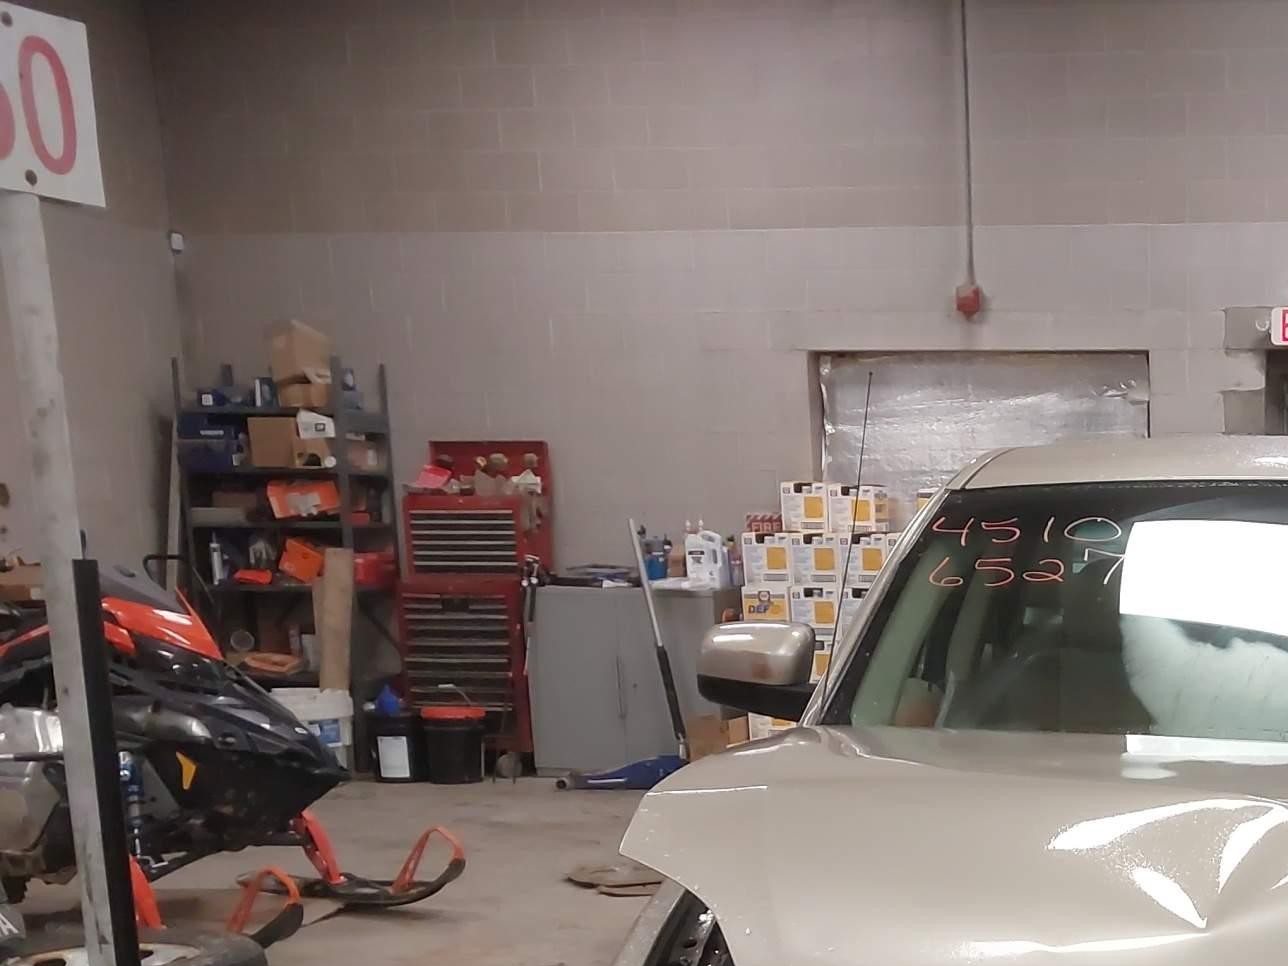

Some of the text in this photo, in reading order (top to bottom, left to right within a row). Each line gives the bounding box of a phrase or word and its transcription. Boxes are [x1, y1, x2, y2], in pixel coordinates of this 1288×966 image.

[751, 521, 782, 533] FIRE
[932, 516, 1122, 547] 4510
[928, 548, 1126, 587] 6527
